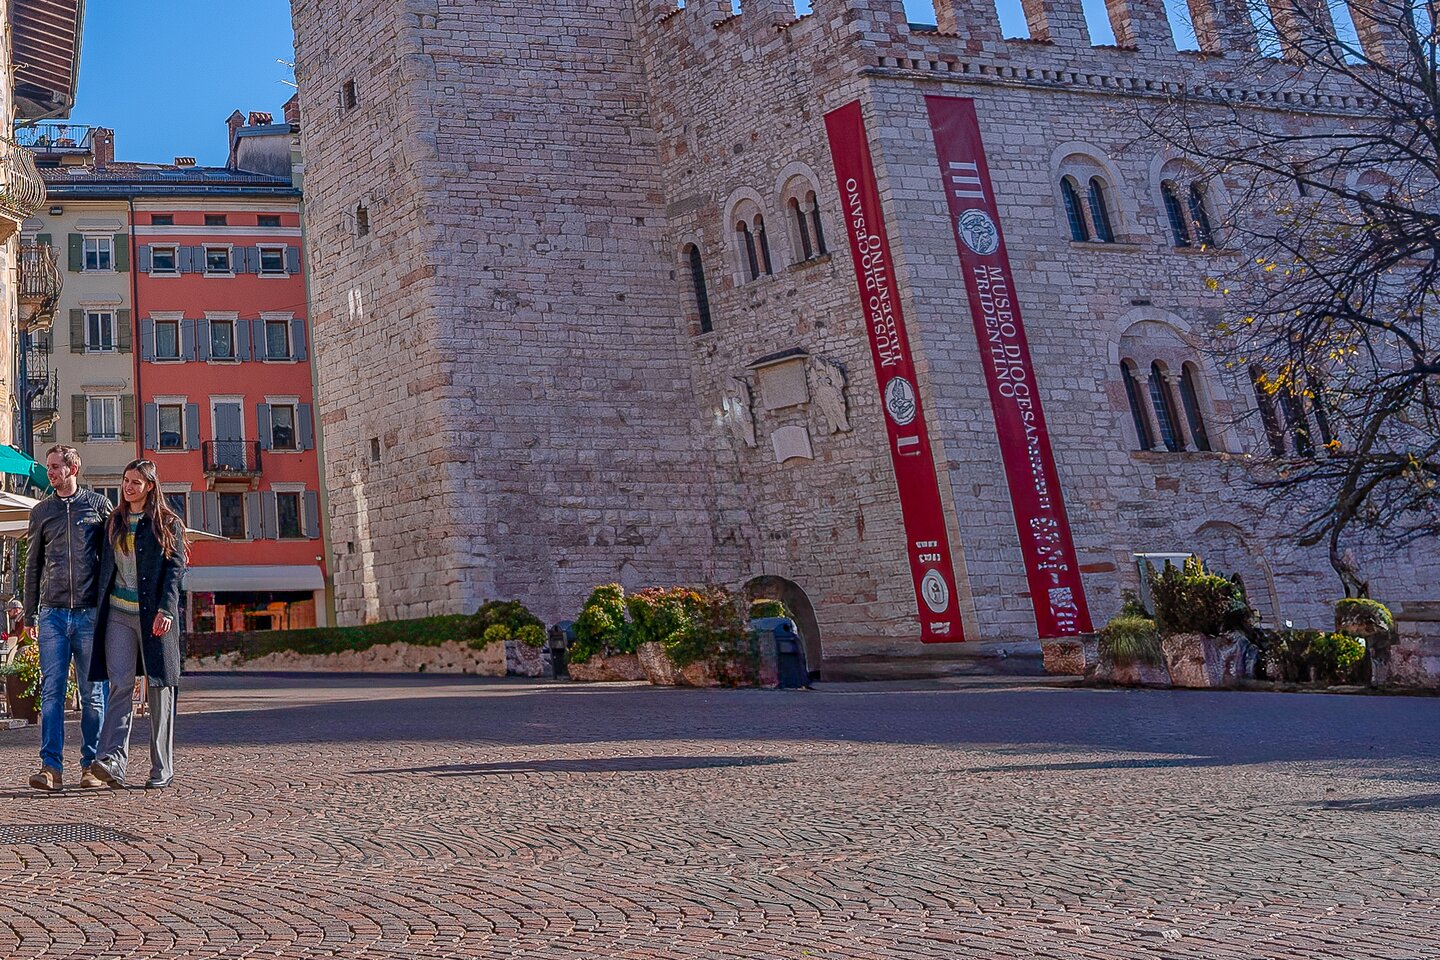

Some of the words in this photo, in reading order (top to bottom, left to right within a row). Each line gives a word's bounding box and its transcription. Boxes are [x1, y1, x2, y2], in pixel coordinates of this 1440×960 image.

[846, 178, 876, 292] DIOCESANO
[868, 234, 903, 363] TRIDENTINO
[869, 296, 896, 367] MUSEO
[973, 264, 1016, 398] TRIDENTINO
[987, 265, 1017, 338] MUSEO
[1004, 343, 1041, 456] DIOCESA
